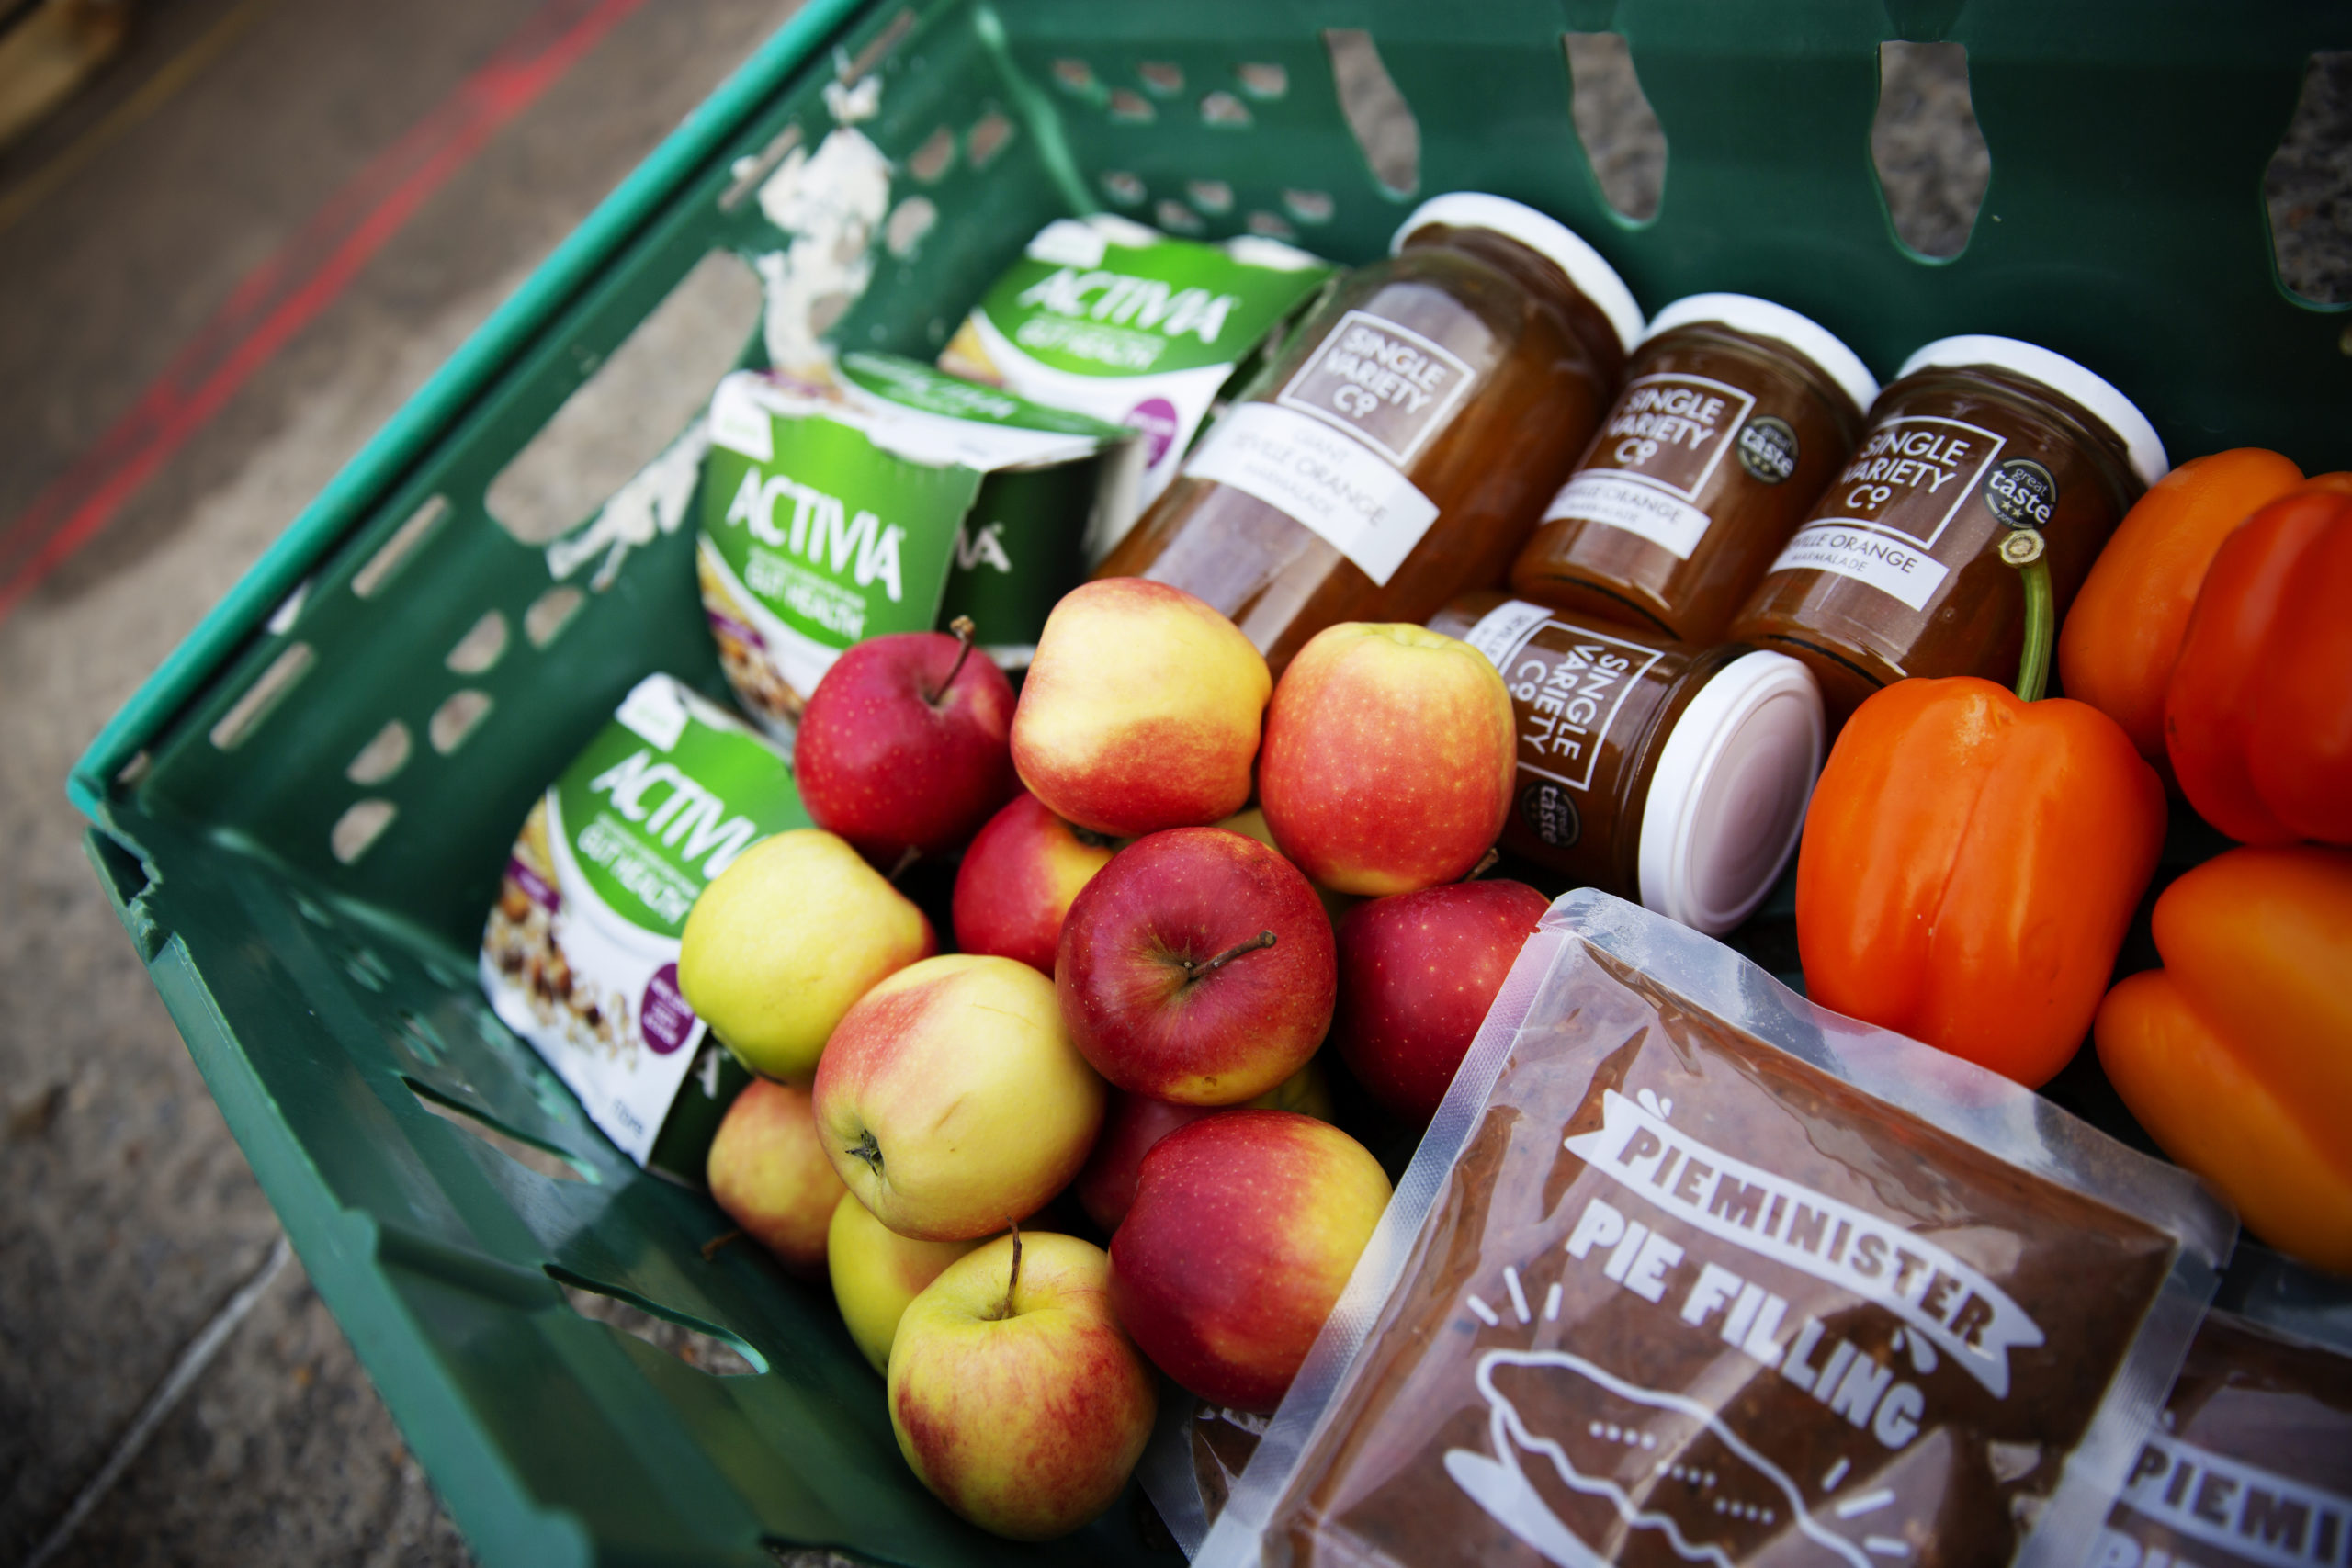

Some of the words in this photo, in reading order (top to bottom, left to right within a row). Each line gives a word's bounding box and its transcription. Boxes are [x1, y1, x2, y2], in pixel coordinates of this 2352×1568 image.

[1326, 347, 1432, 416] VARIETY
[1343, 326, 1448, 392] SINGLE
[1609, 413, 1715, 450] VARIETY
[1624, 387, 1725, 425] SINGLE
[1740, 426, 1794, 478] taste
[1841, 457, 1958, 494] VARIETY
[1860, 430, 1971, 468] SINGLE
[1295, 457, 1388, 527] ORANGE
[1601, 488, 1683, 524] ORANGE
[1989, 469, 2052, 525] taste
[2011, 468, 2049, 497] great
[725, 464, 903, 604] ACTIVIA
[1829, 534, 1919, 575] ORANGE
[1792, 551, 1869, 574] MARMALADE
[1522, 645, 1606, 756] VARIETY
[1552, 653, 1630, 761] SINGLE
[1616, 1125, 1996, 1347] PIEMINISTER
[1565, 1198, 1685, 1303] PIE
[1680, 1260, 1926, 1450] FILLING
